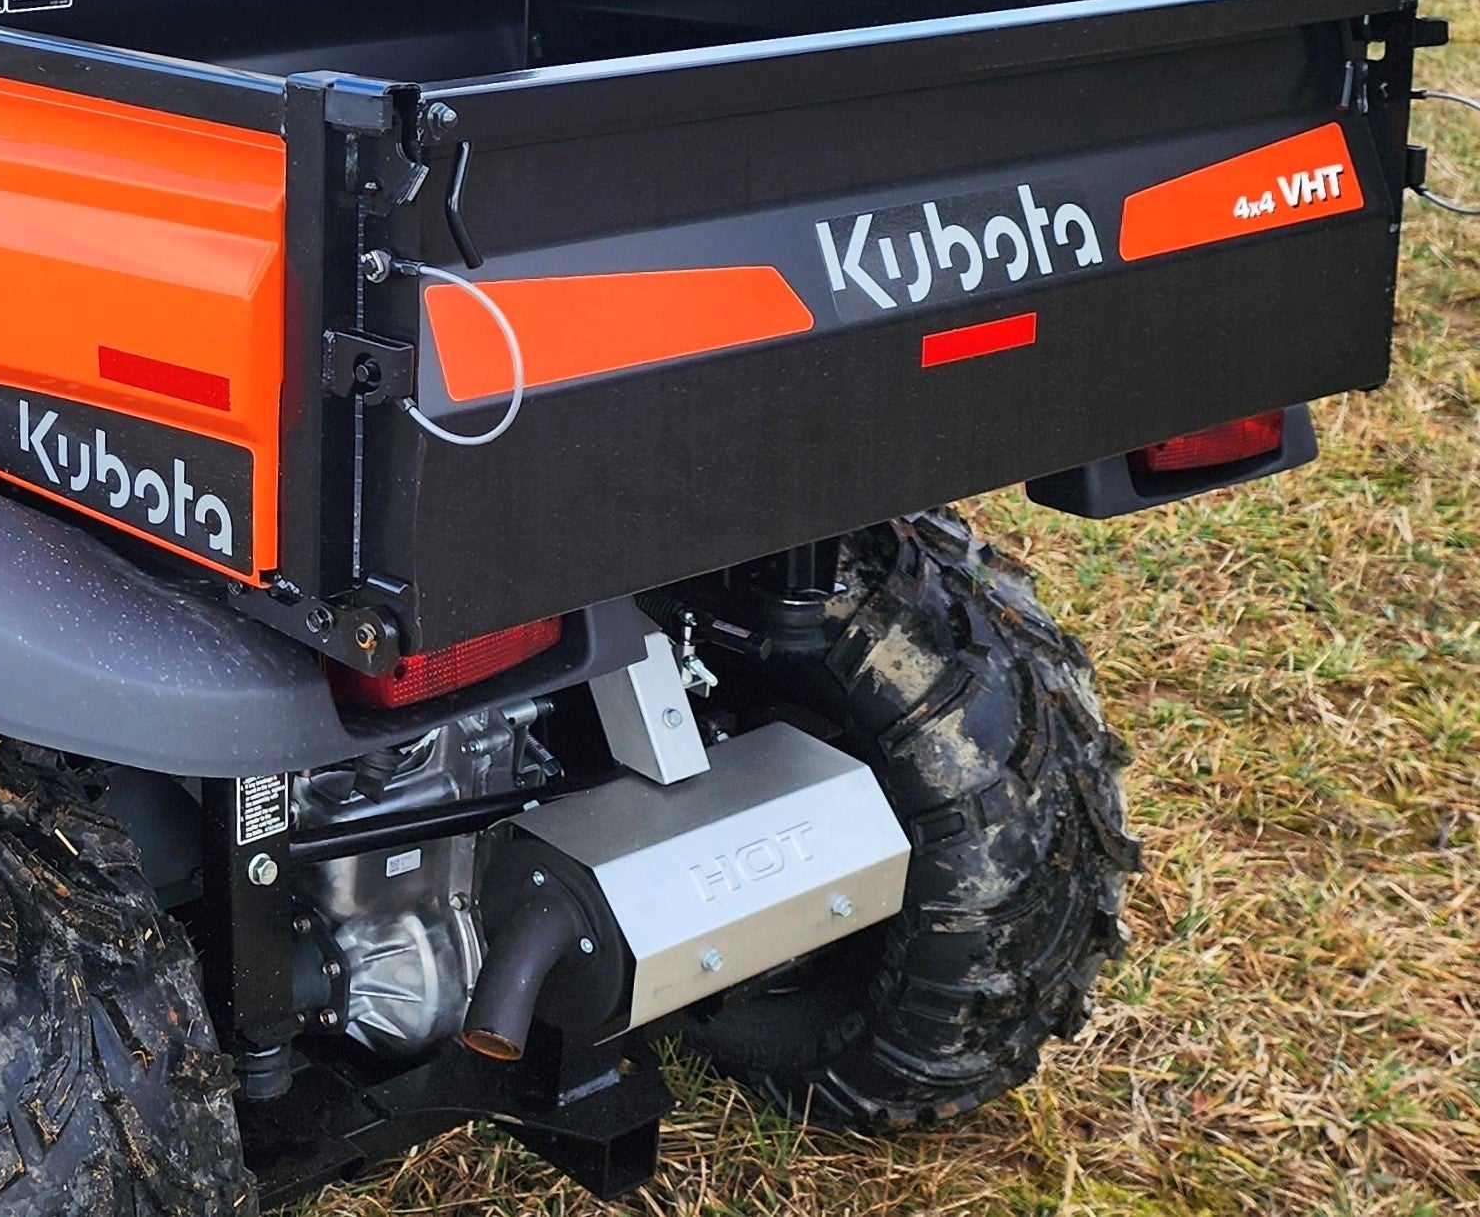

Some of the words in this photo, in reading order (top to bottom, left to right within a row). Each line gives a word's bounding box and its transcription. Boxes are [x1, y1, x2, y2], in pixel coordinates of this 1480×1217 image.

[1233, 190, 1276, 219] 4x4
[1276, 164, 1344, 208] VHT
[816, 184, 1103, 310] Kubota
[20, 400, 233, 557] Kubota
[688, 820, 814, 902] HOT
